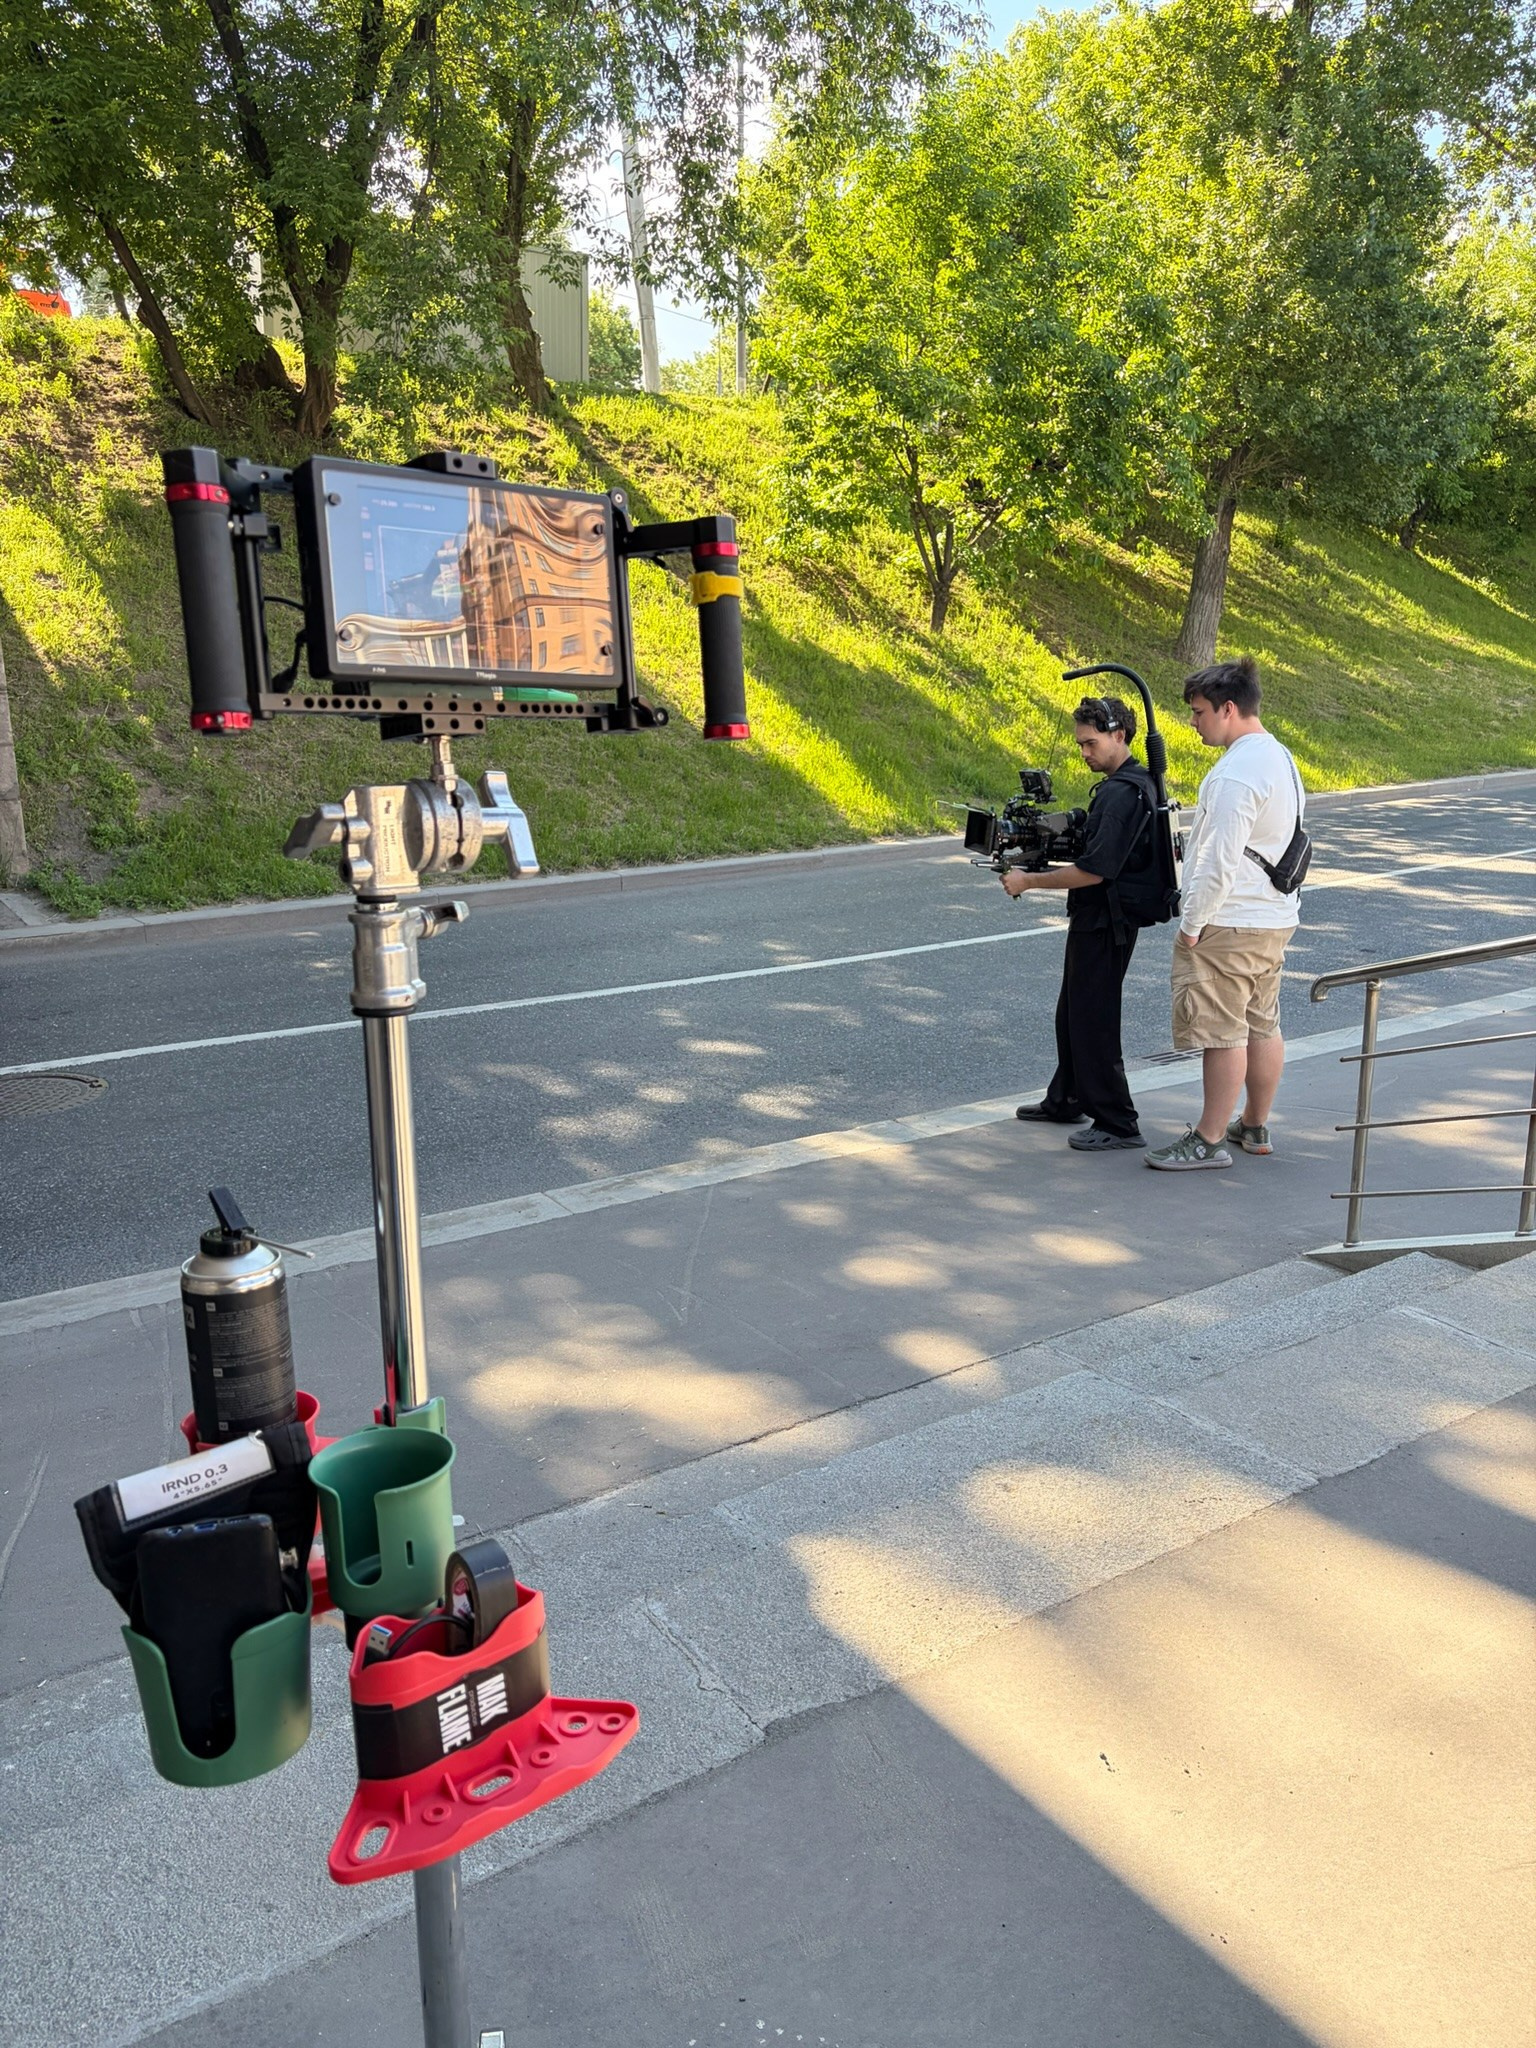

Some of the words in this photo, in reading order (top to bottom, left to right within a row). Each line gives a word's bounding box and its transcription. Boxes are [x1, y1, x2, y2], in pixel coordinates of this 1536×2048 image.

[161, 1473, 201, 1493] IRND
[204, 1463, 228, 1478] 0.3
[436, 1683, 472, 1754] FLAME
[476, 1672, 508, 1726] MAK
